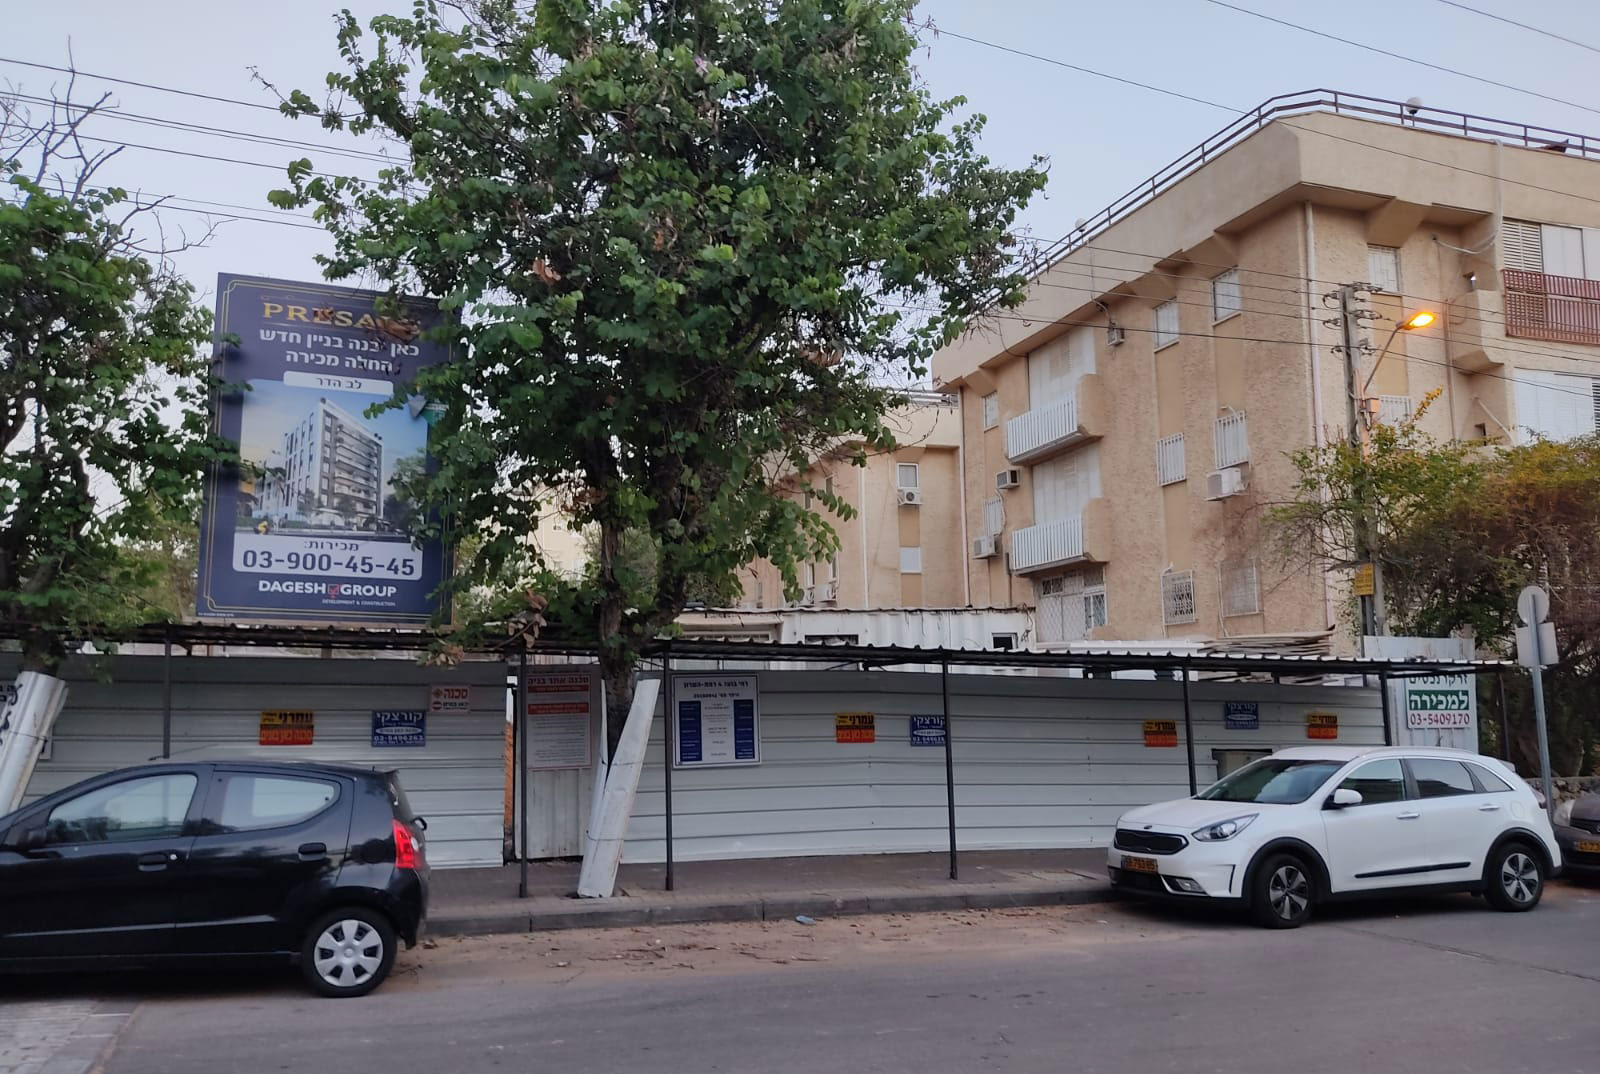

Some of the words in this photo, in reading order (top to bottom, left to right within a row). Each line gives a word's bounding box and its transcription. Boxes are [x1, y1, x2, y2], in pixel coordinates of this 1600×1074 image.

[259, 328, 301, 343] חדש
[306, 333, 344, 349] בניין
[285, 350, 339, 366] מכירה
[391, 342, 419, 358] כאן
[345, 379, 362, 390] לב
[303, 540, 359, 552] מכירות:
[242, 550, 415, 576] 03-900-45-45
[258, 580, 326, 594] DAGESH
[340, 584, 397, 597] GROUP
[1410, 691, 1468, 710] למכירה
[1410, 713, 1470, 726] 03-5409170
